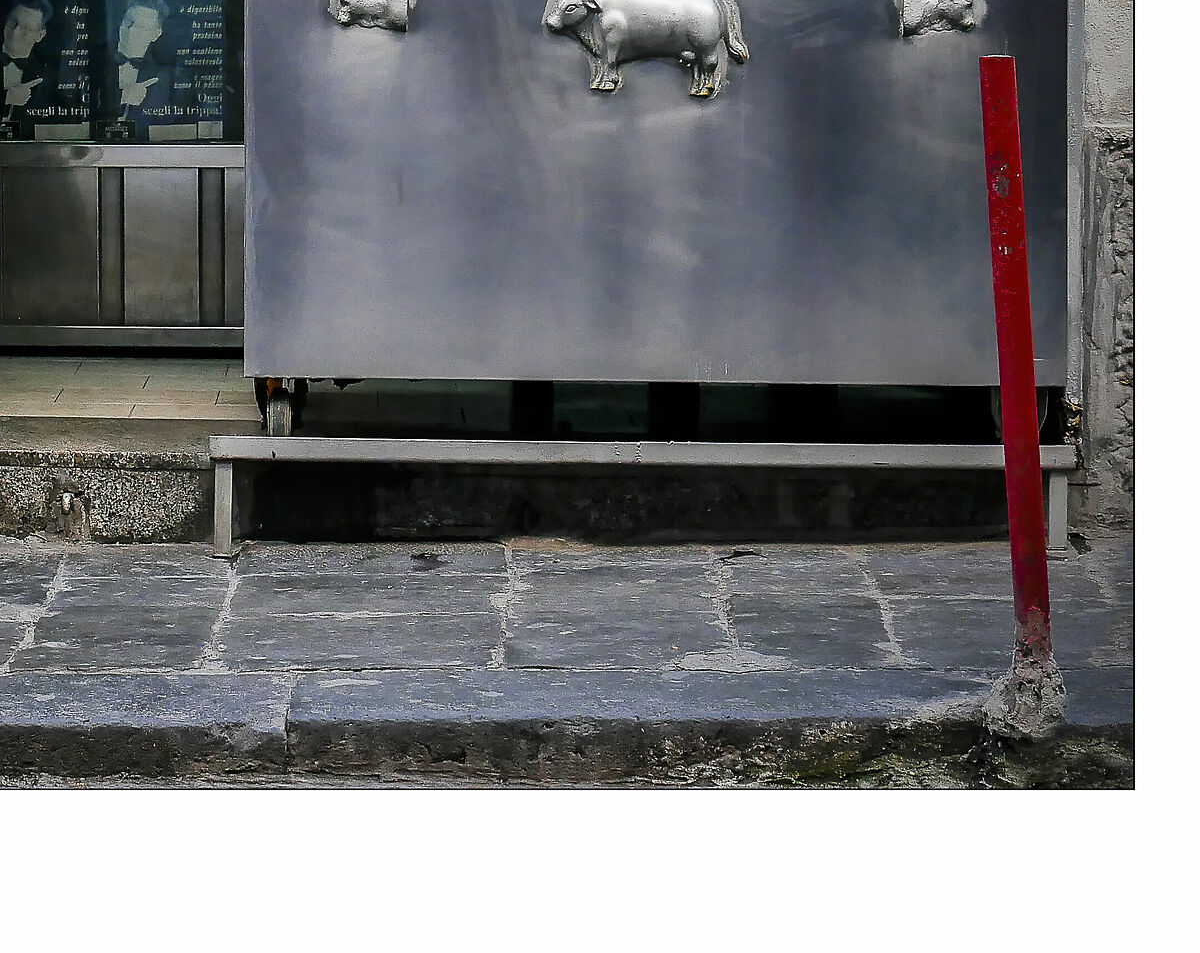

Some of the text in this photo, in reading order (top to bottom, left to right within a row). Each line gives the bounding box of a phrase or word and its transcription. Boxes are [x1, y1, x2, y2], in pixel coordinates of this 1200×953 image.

[26, 106, 55, 117] scegli
[57, 106, 68, 116] la
[142, 105, 171, 117] scegli
[173, 105, 184, 115] la
